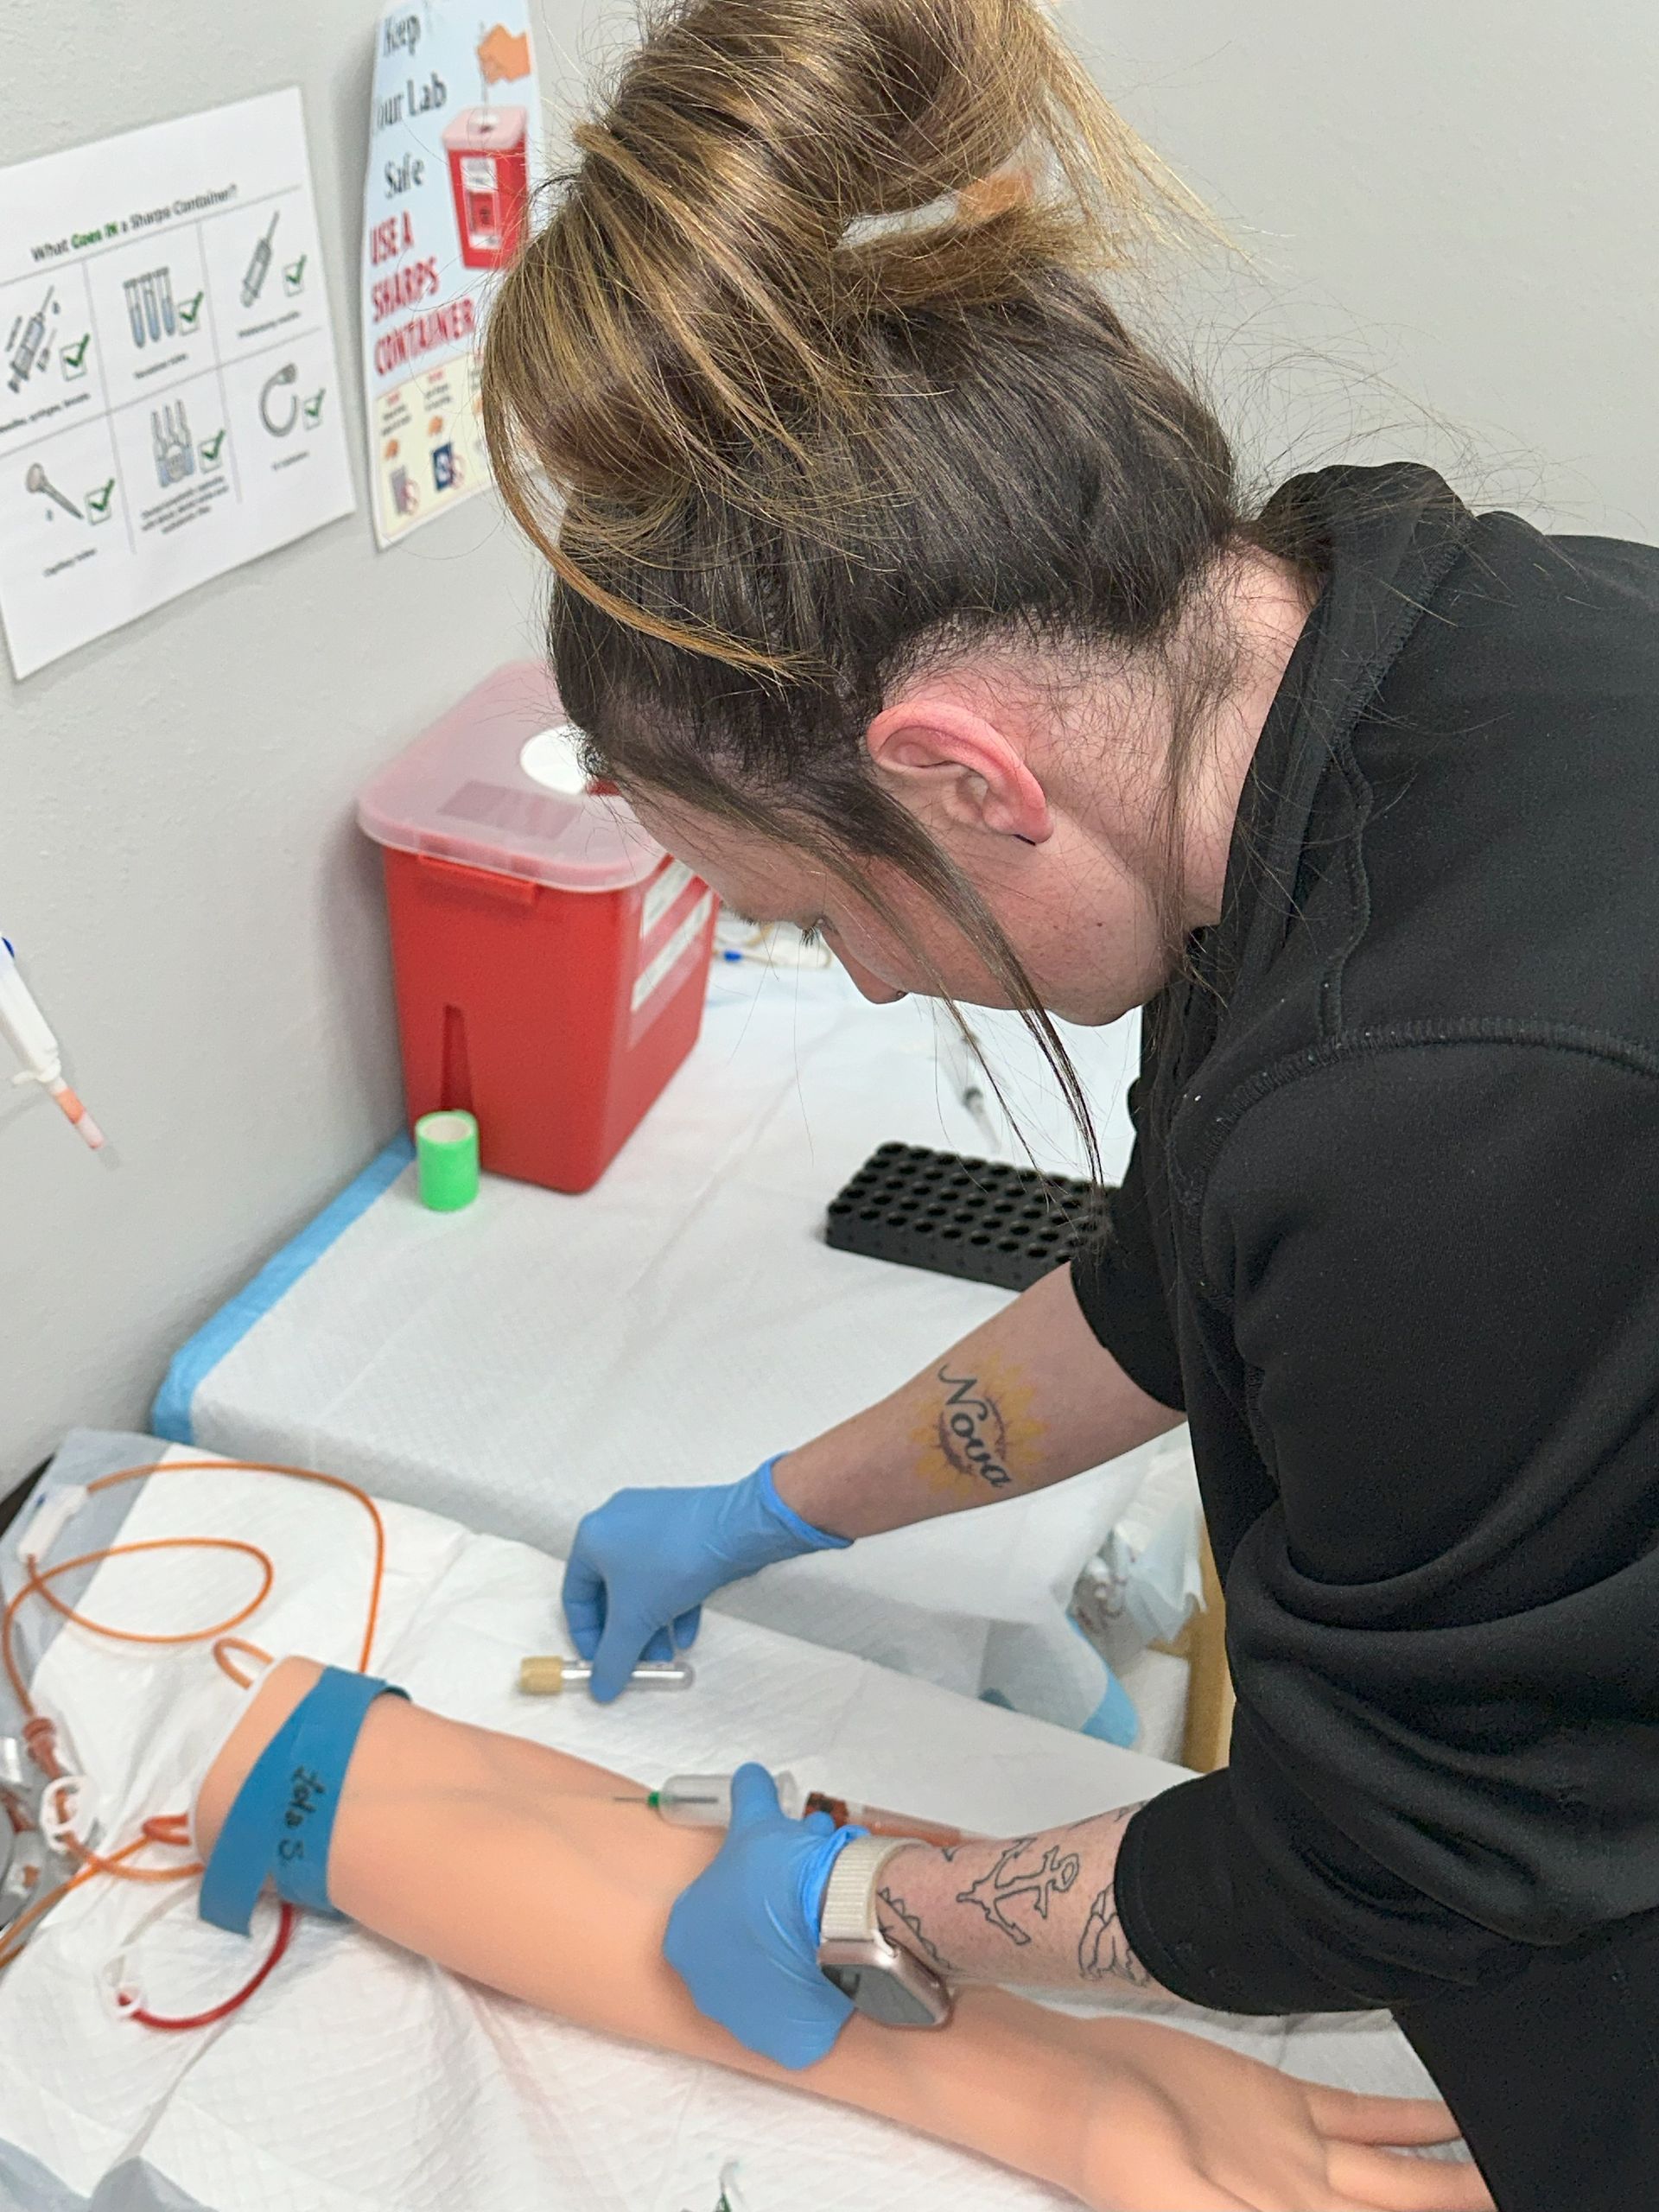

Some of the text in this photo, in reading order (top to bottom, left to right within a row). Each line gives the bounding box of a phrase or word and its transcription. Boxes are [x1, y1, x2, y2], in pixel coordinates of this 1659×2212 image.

[375, 71, 448, 131] our Lab
[385, 152, 425, 200] Safe
[31, 239, 69, 262] What
[129, 205, 172, 231] Sharps
[173, 183, 238, 216] Container?
[370, 210, 415, 266] USE A
[372, 256, 439, 323] SHARPS
[373, 298, 476, 377] CONTAINER
[938, 1364, 1012, 1489] Nova
